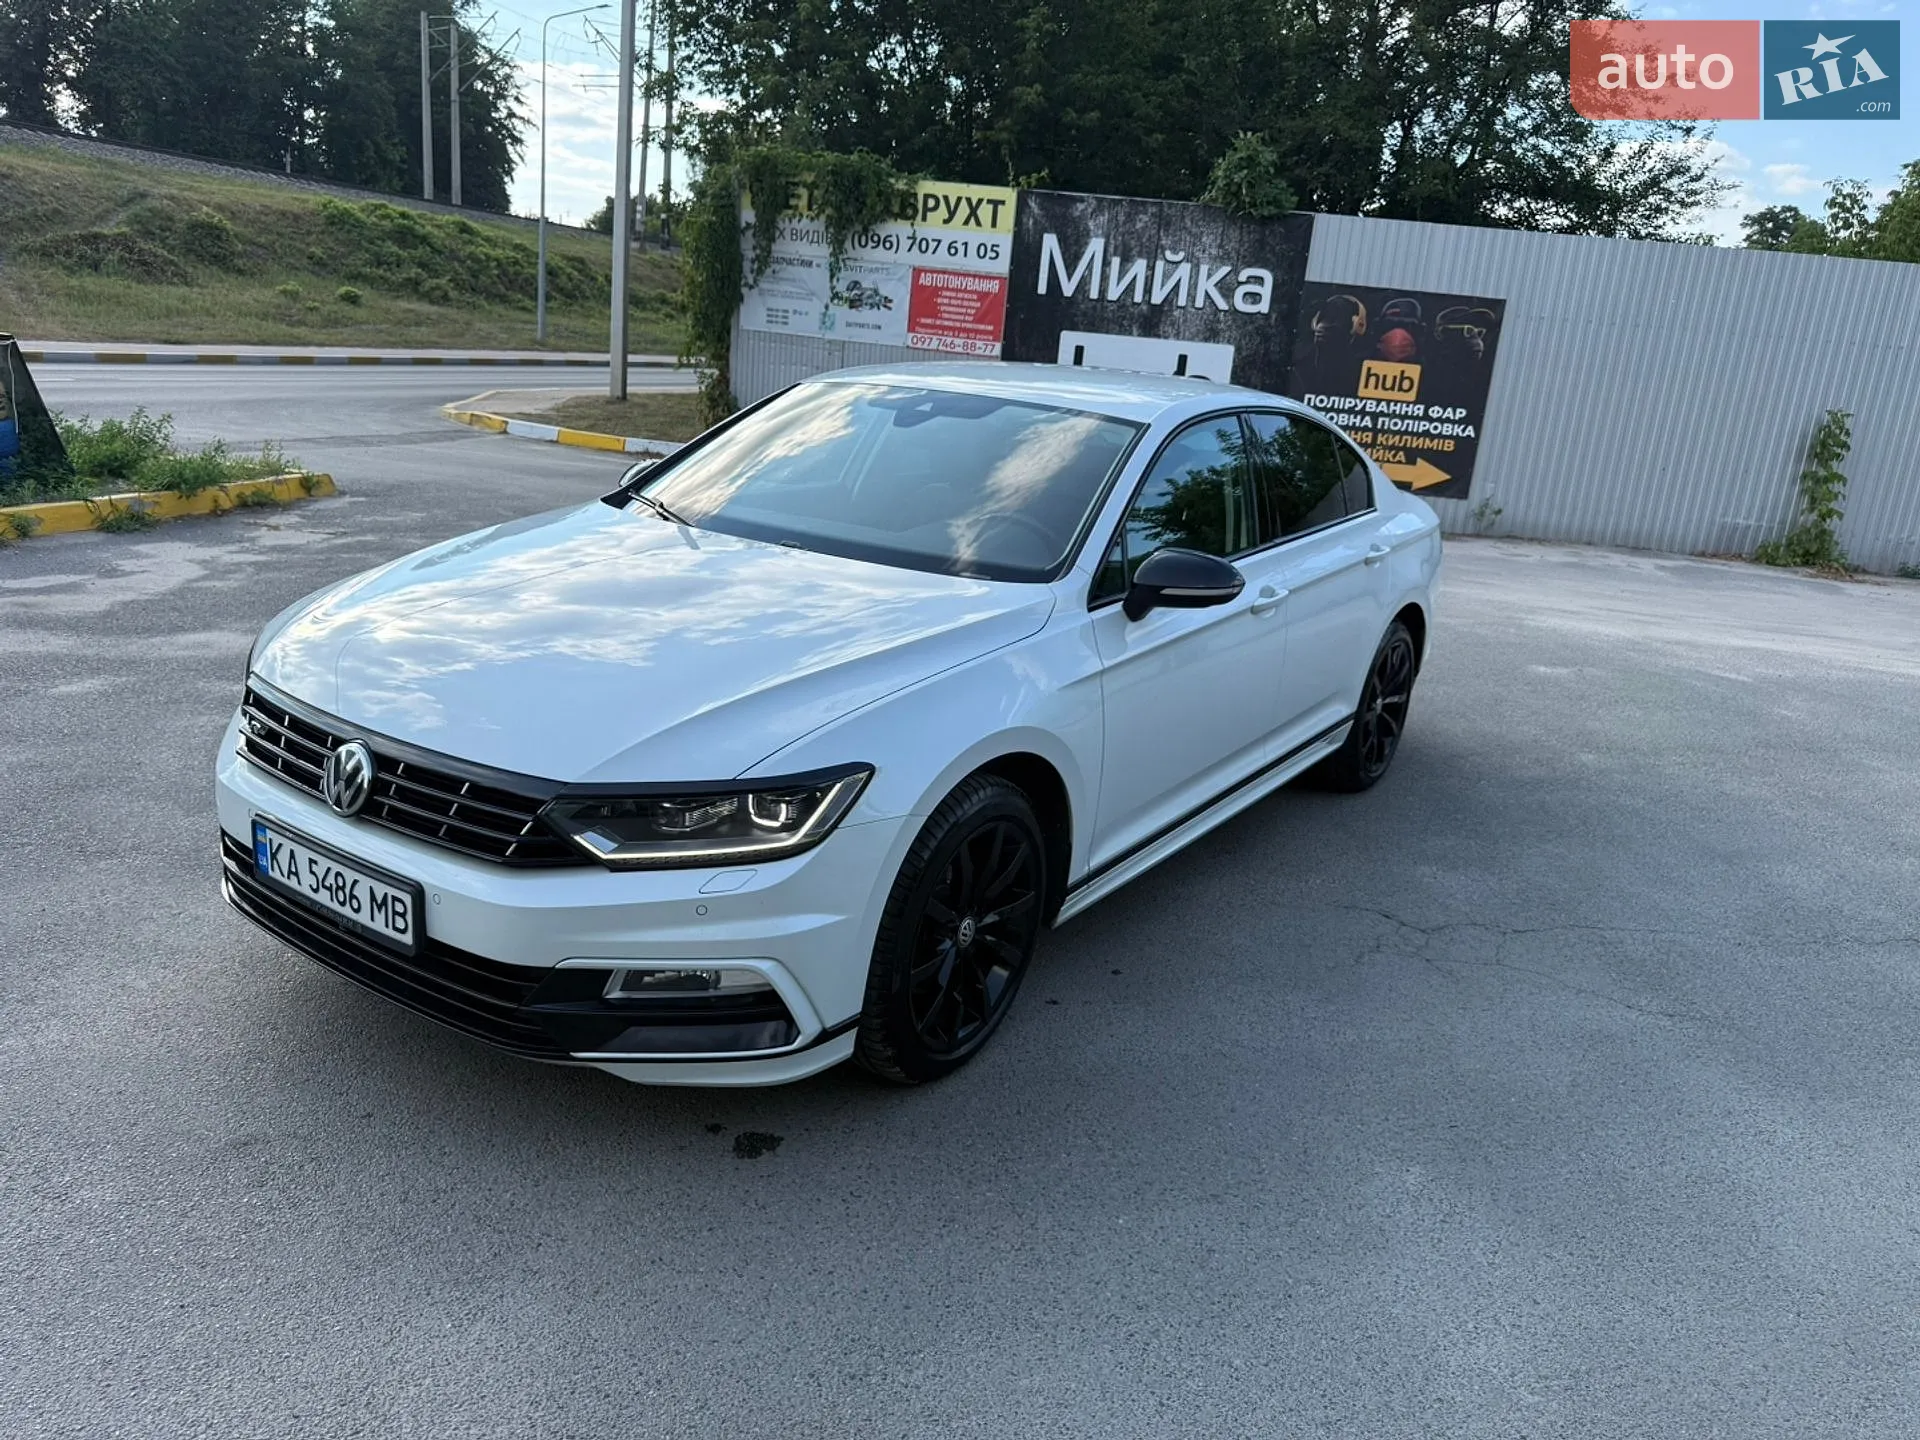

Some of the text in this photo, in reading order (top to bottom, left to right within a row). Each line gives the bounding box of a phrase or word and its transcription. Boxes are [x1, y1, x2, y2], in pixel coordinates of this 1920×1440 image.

[851, 232, 1000, 260] (096) 707 61 05
[918, 272, 999, 293] АВТОТОНУВАННЯ
[1037, 233, 1274, 315] Мийка
[911, 335, 996, 353] 097 746-88-77
[1364, 367, 1415, 394] hub
[1303, 393, 1467, 420] ПОЛІРУВАННЯ ФАР
[1377, 417, 1476, 439] ПОЛІРОВКА
[1377, 433, 1456, 452] КИЛИМІВ
[268, 837, 302, 887] KA
[308, 857, 362, 914] 5486
[369, 885, 409, 935] MB
